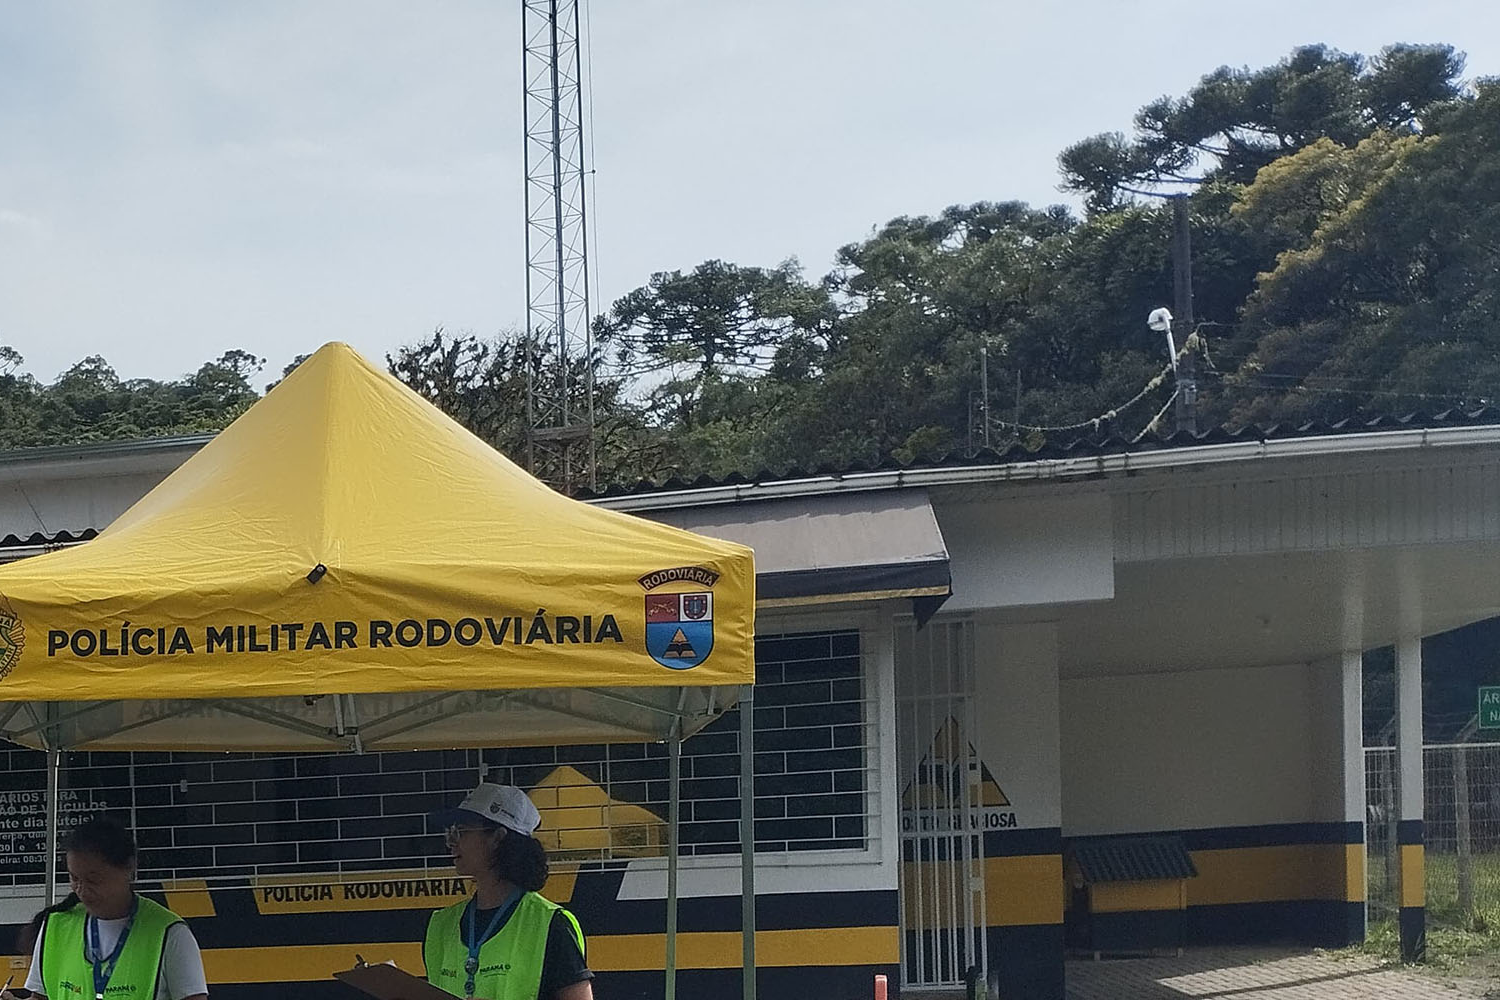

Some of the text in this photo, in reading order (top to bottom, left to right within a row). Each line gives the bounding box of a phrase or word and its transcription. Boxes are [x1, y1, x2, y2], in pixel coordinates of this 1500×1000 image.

[642, 567, 714, 589] RODOVIÁRIA
[47, 608, 624, 657] POLÍCIA MILITAR RODOVIÁRIA
[20, 804, 37, 815] DE
